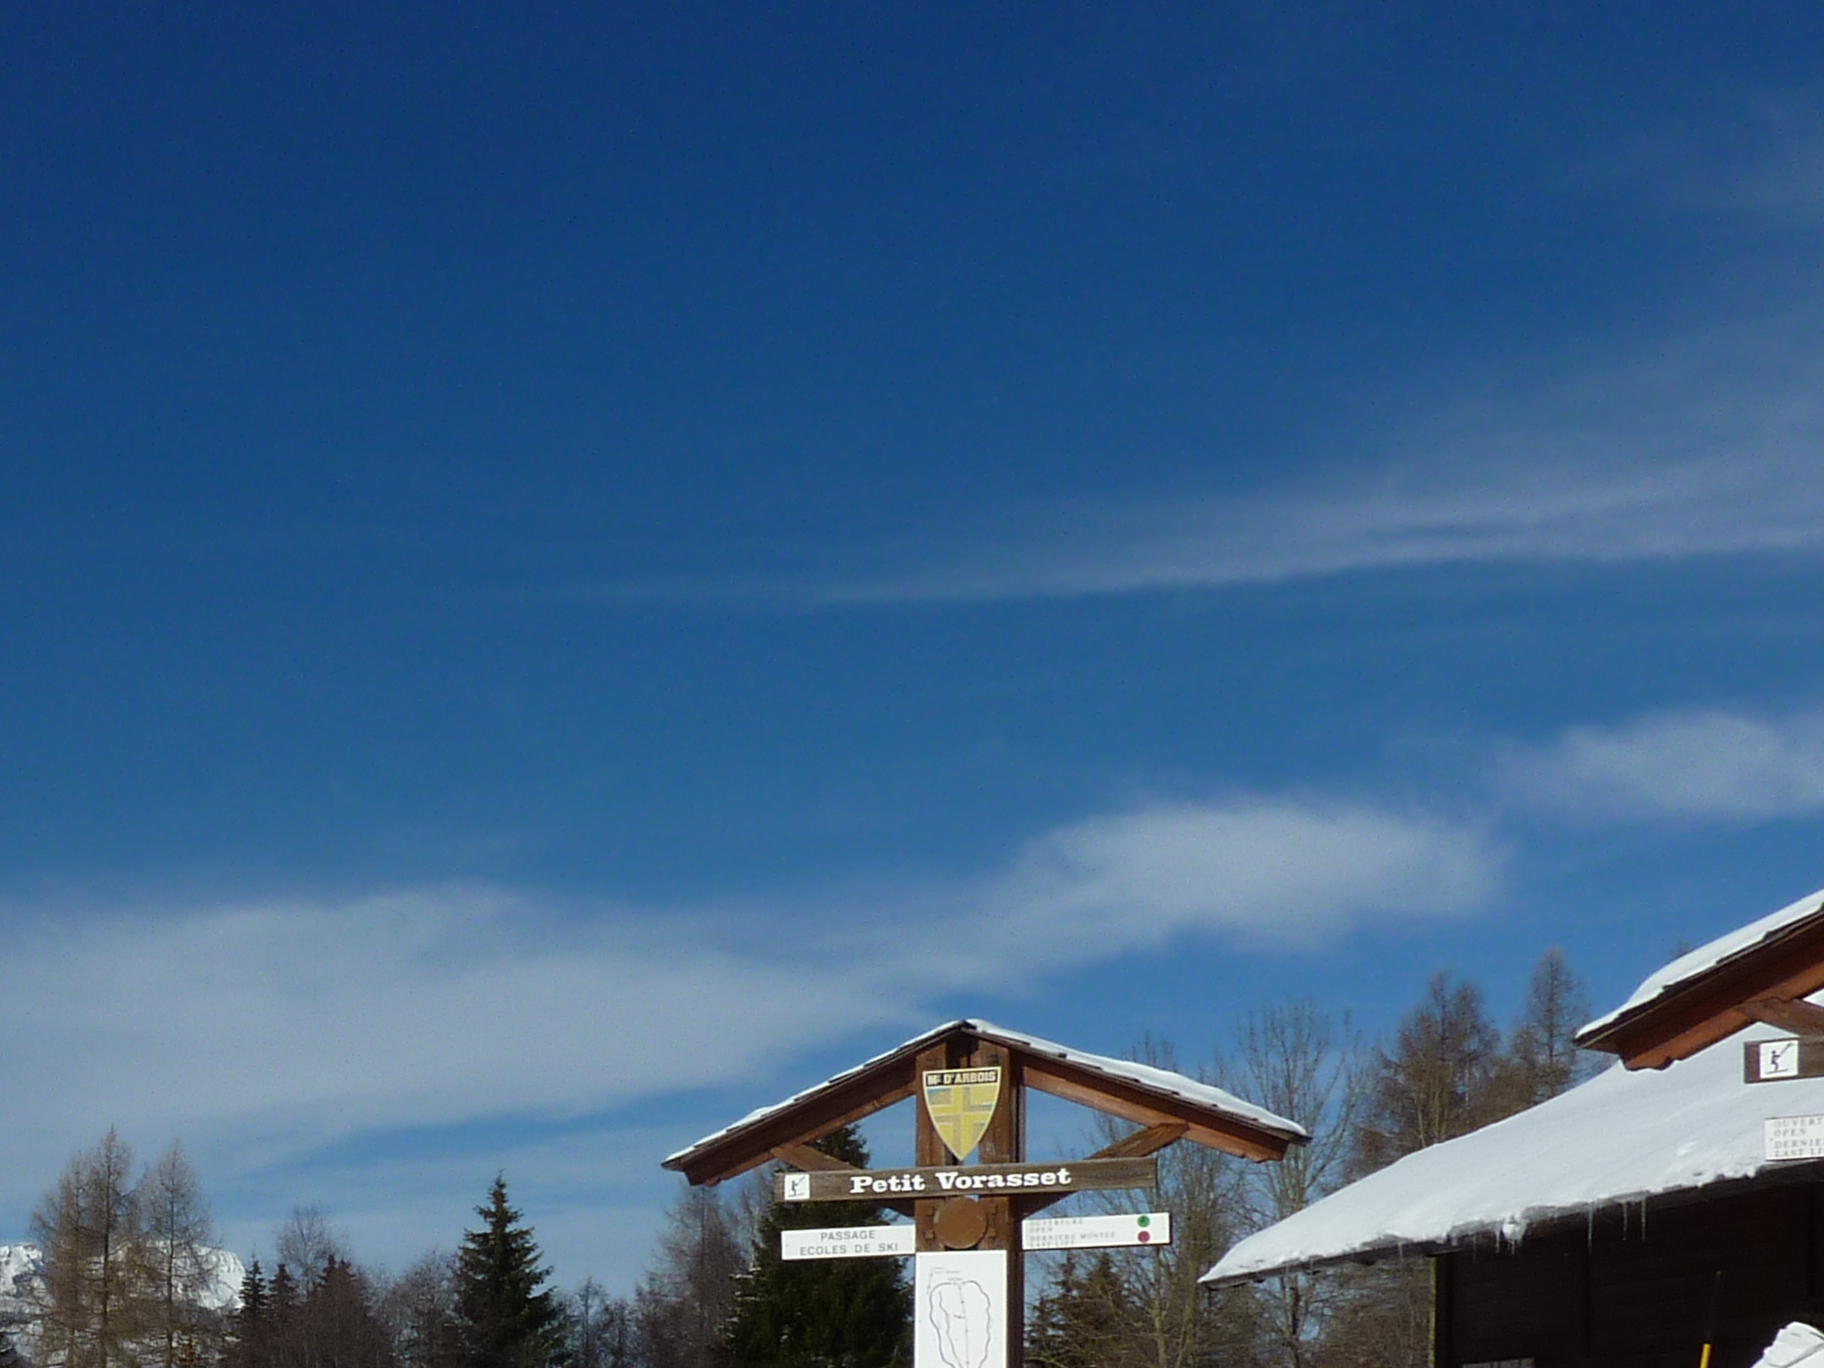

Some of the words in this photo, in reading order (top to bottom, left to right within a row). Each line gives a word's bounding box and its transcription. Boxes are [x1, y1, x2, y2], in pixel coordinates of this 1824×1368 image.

[943, 1071, 996, 1085] D'ARBOIS
[1774, 1128, 1806, 1138] OPEN
[1774, 1138, 1824, 1149] DERNIE
[849, 1174, 926, 1194] Petit
[934, 1168, 1072, 1190] Vorasset
[820, 1229, 876, 1241] PASSAGE
[799, 1244, 847, 1256] ECOLES
[854, 1243, 871, 1254] DE
[878, 1242, 899, 1253] SKI
